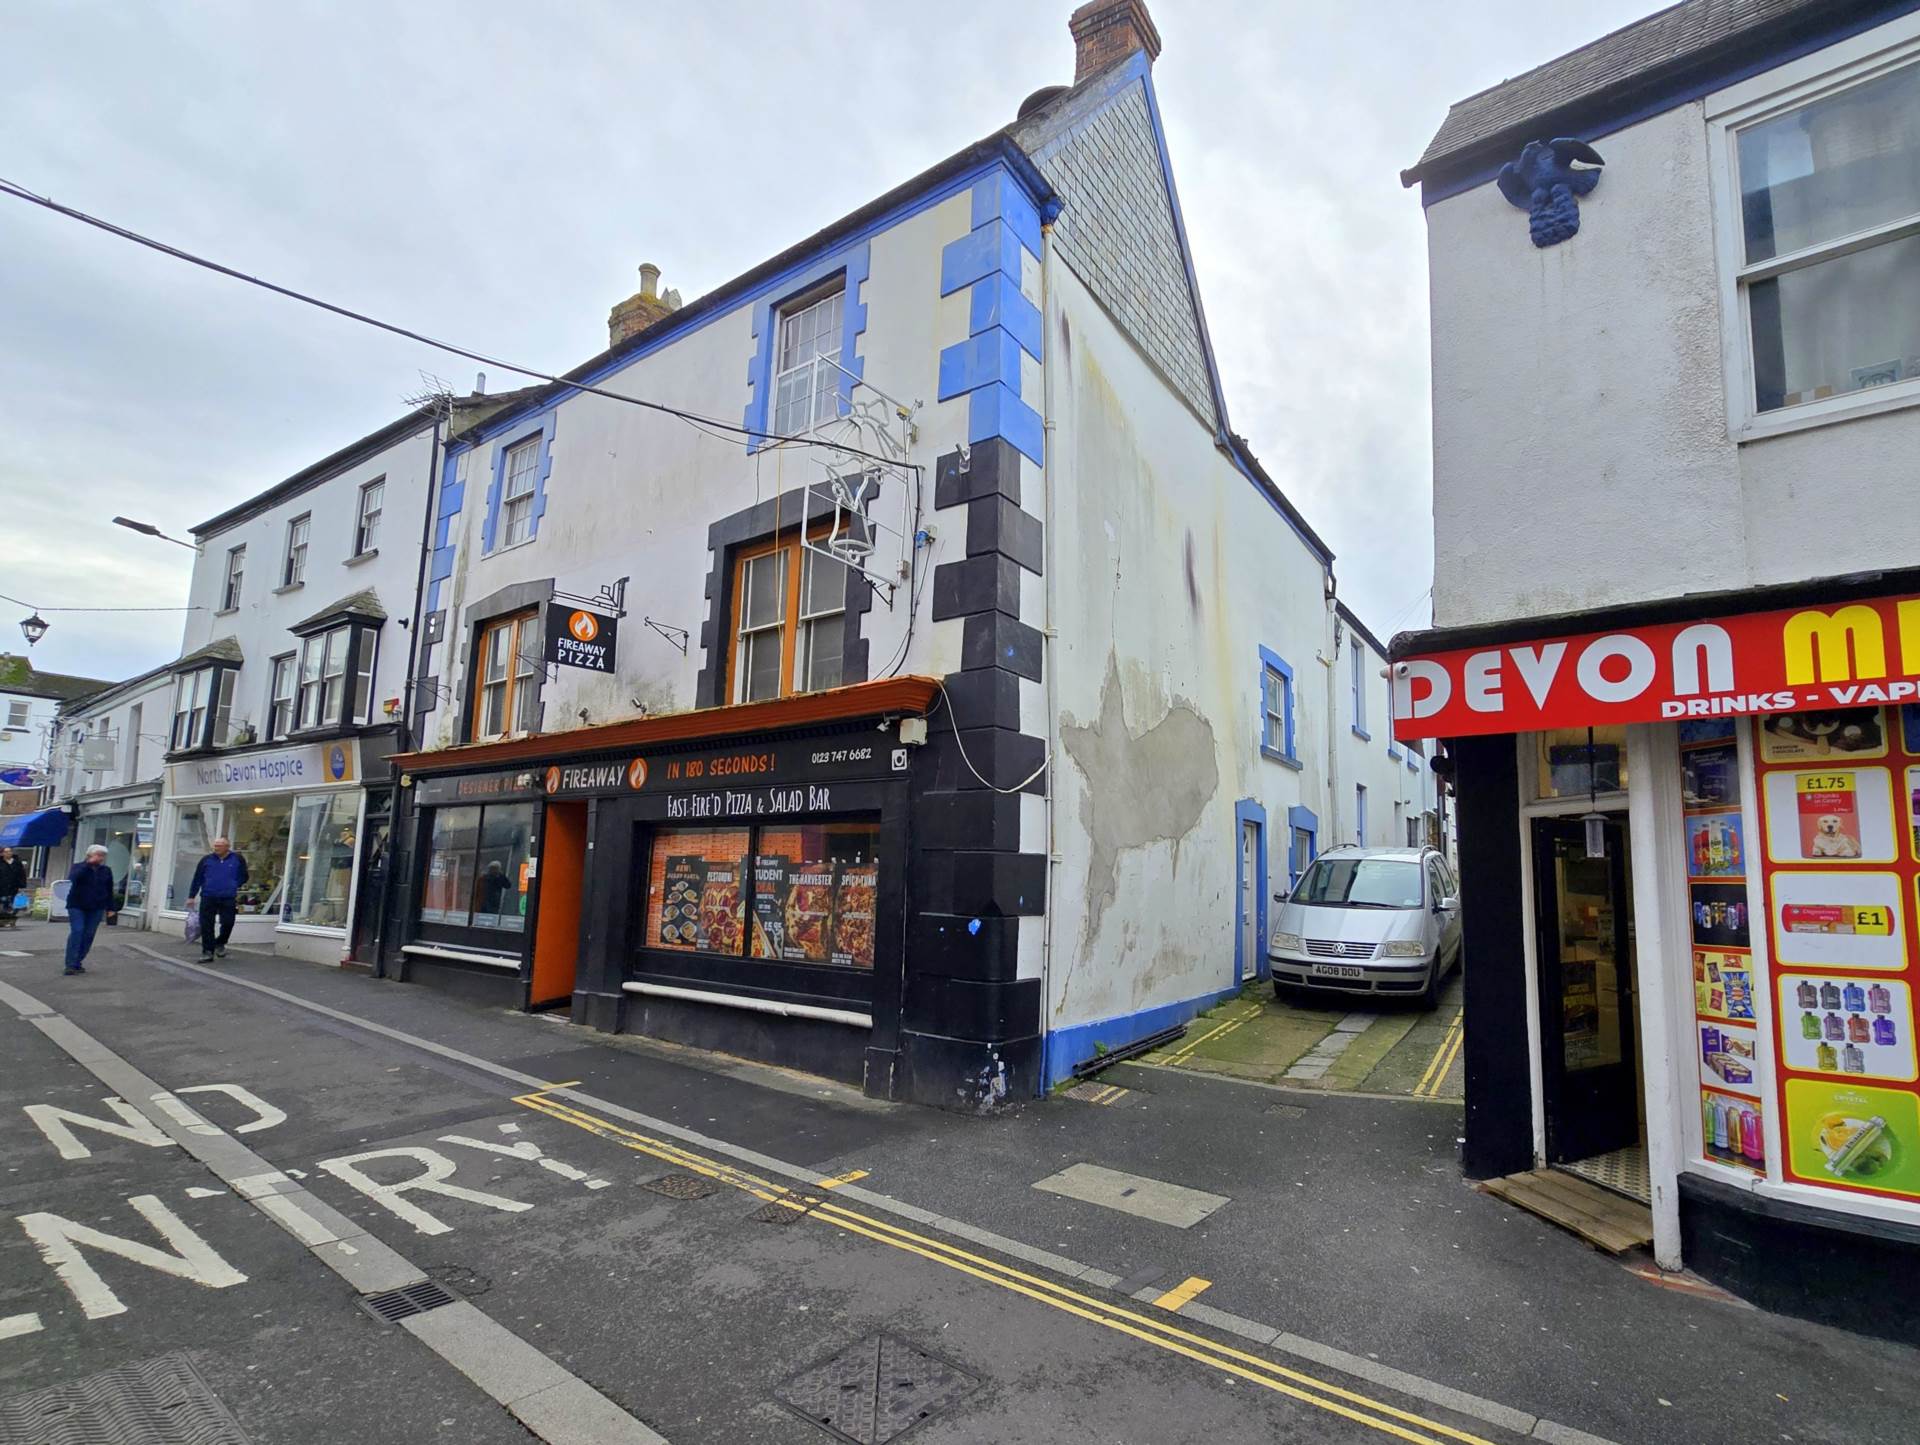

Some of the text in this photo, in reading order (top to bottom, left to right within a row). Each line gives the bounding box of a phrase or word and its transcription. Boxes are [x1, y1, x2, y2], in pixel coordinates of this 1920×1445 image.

[557, 637, 606, 657] FIREAWAY
[557, 649, 605, 670] PIZZA
[1394, 623, 1735, 720] DEVON
[1661, 691, 1796, 718] DRINKS
[1828, 680, 1920, 705] VAP
[831, 750, 847, 762] 747
[849, 748, 872, 760] 6682
[197, 755, 303, 785] North Devon Hospice
[562, 765, 625, 790] FIREAWAY
[667, 762, 680, 780] IN
[685, 759, 704, 778] 180
[459, 779, 500, 795] DESIGNER
[1806, 776, 1846, 790] £1.75
[726, 788, 752, 816] PIZZA
[756, 798, 765, 814] &
[769, 787, 803, 813] SALAD
[808, 784, 831, 811] BAR
[1857, 911, 1884, 926] £1
